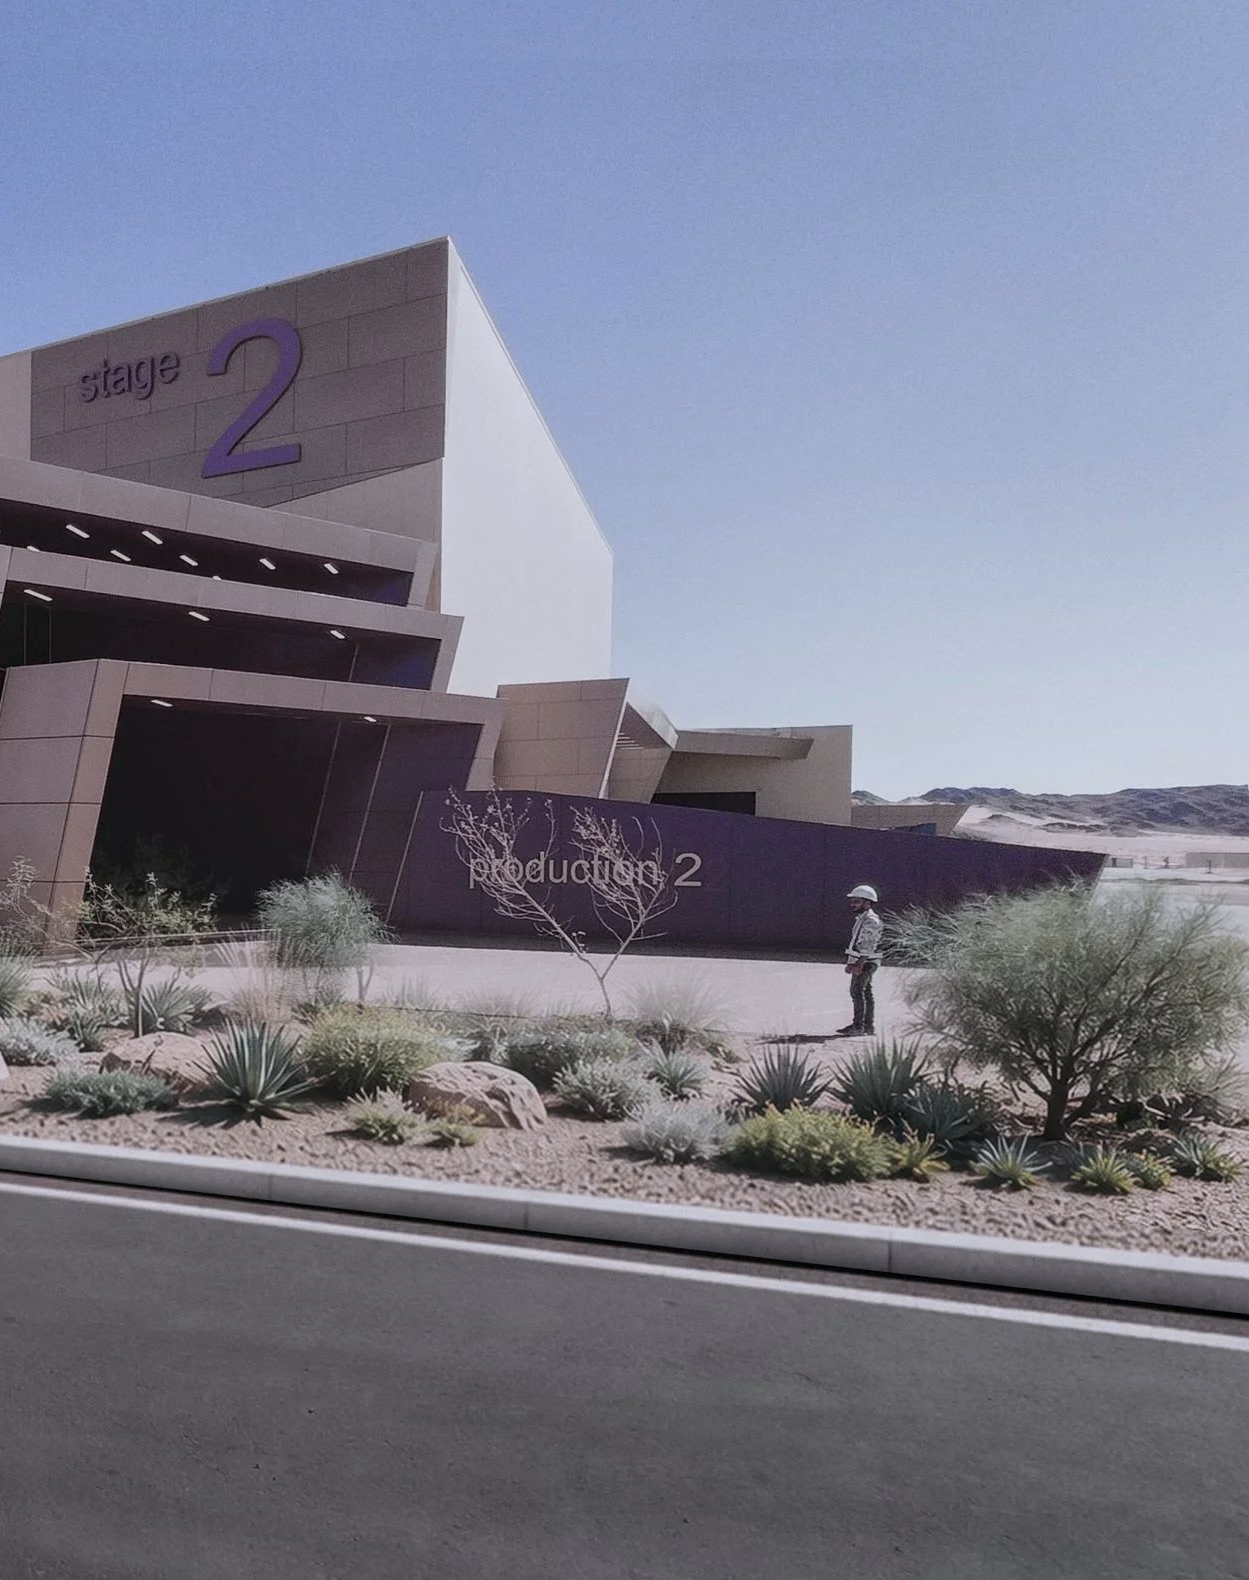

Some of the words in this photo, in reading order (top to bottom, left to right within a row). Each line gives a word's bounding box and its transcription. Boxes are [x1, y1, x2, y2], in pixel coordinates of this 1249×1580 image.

[80, 352, 180, 403] stage
[202, 317, 302, 479] 2
[674, 853, 702, 887] 2
